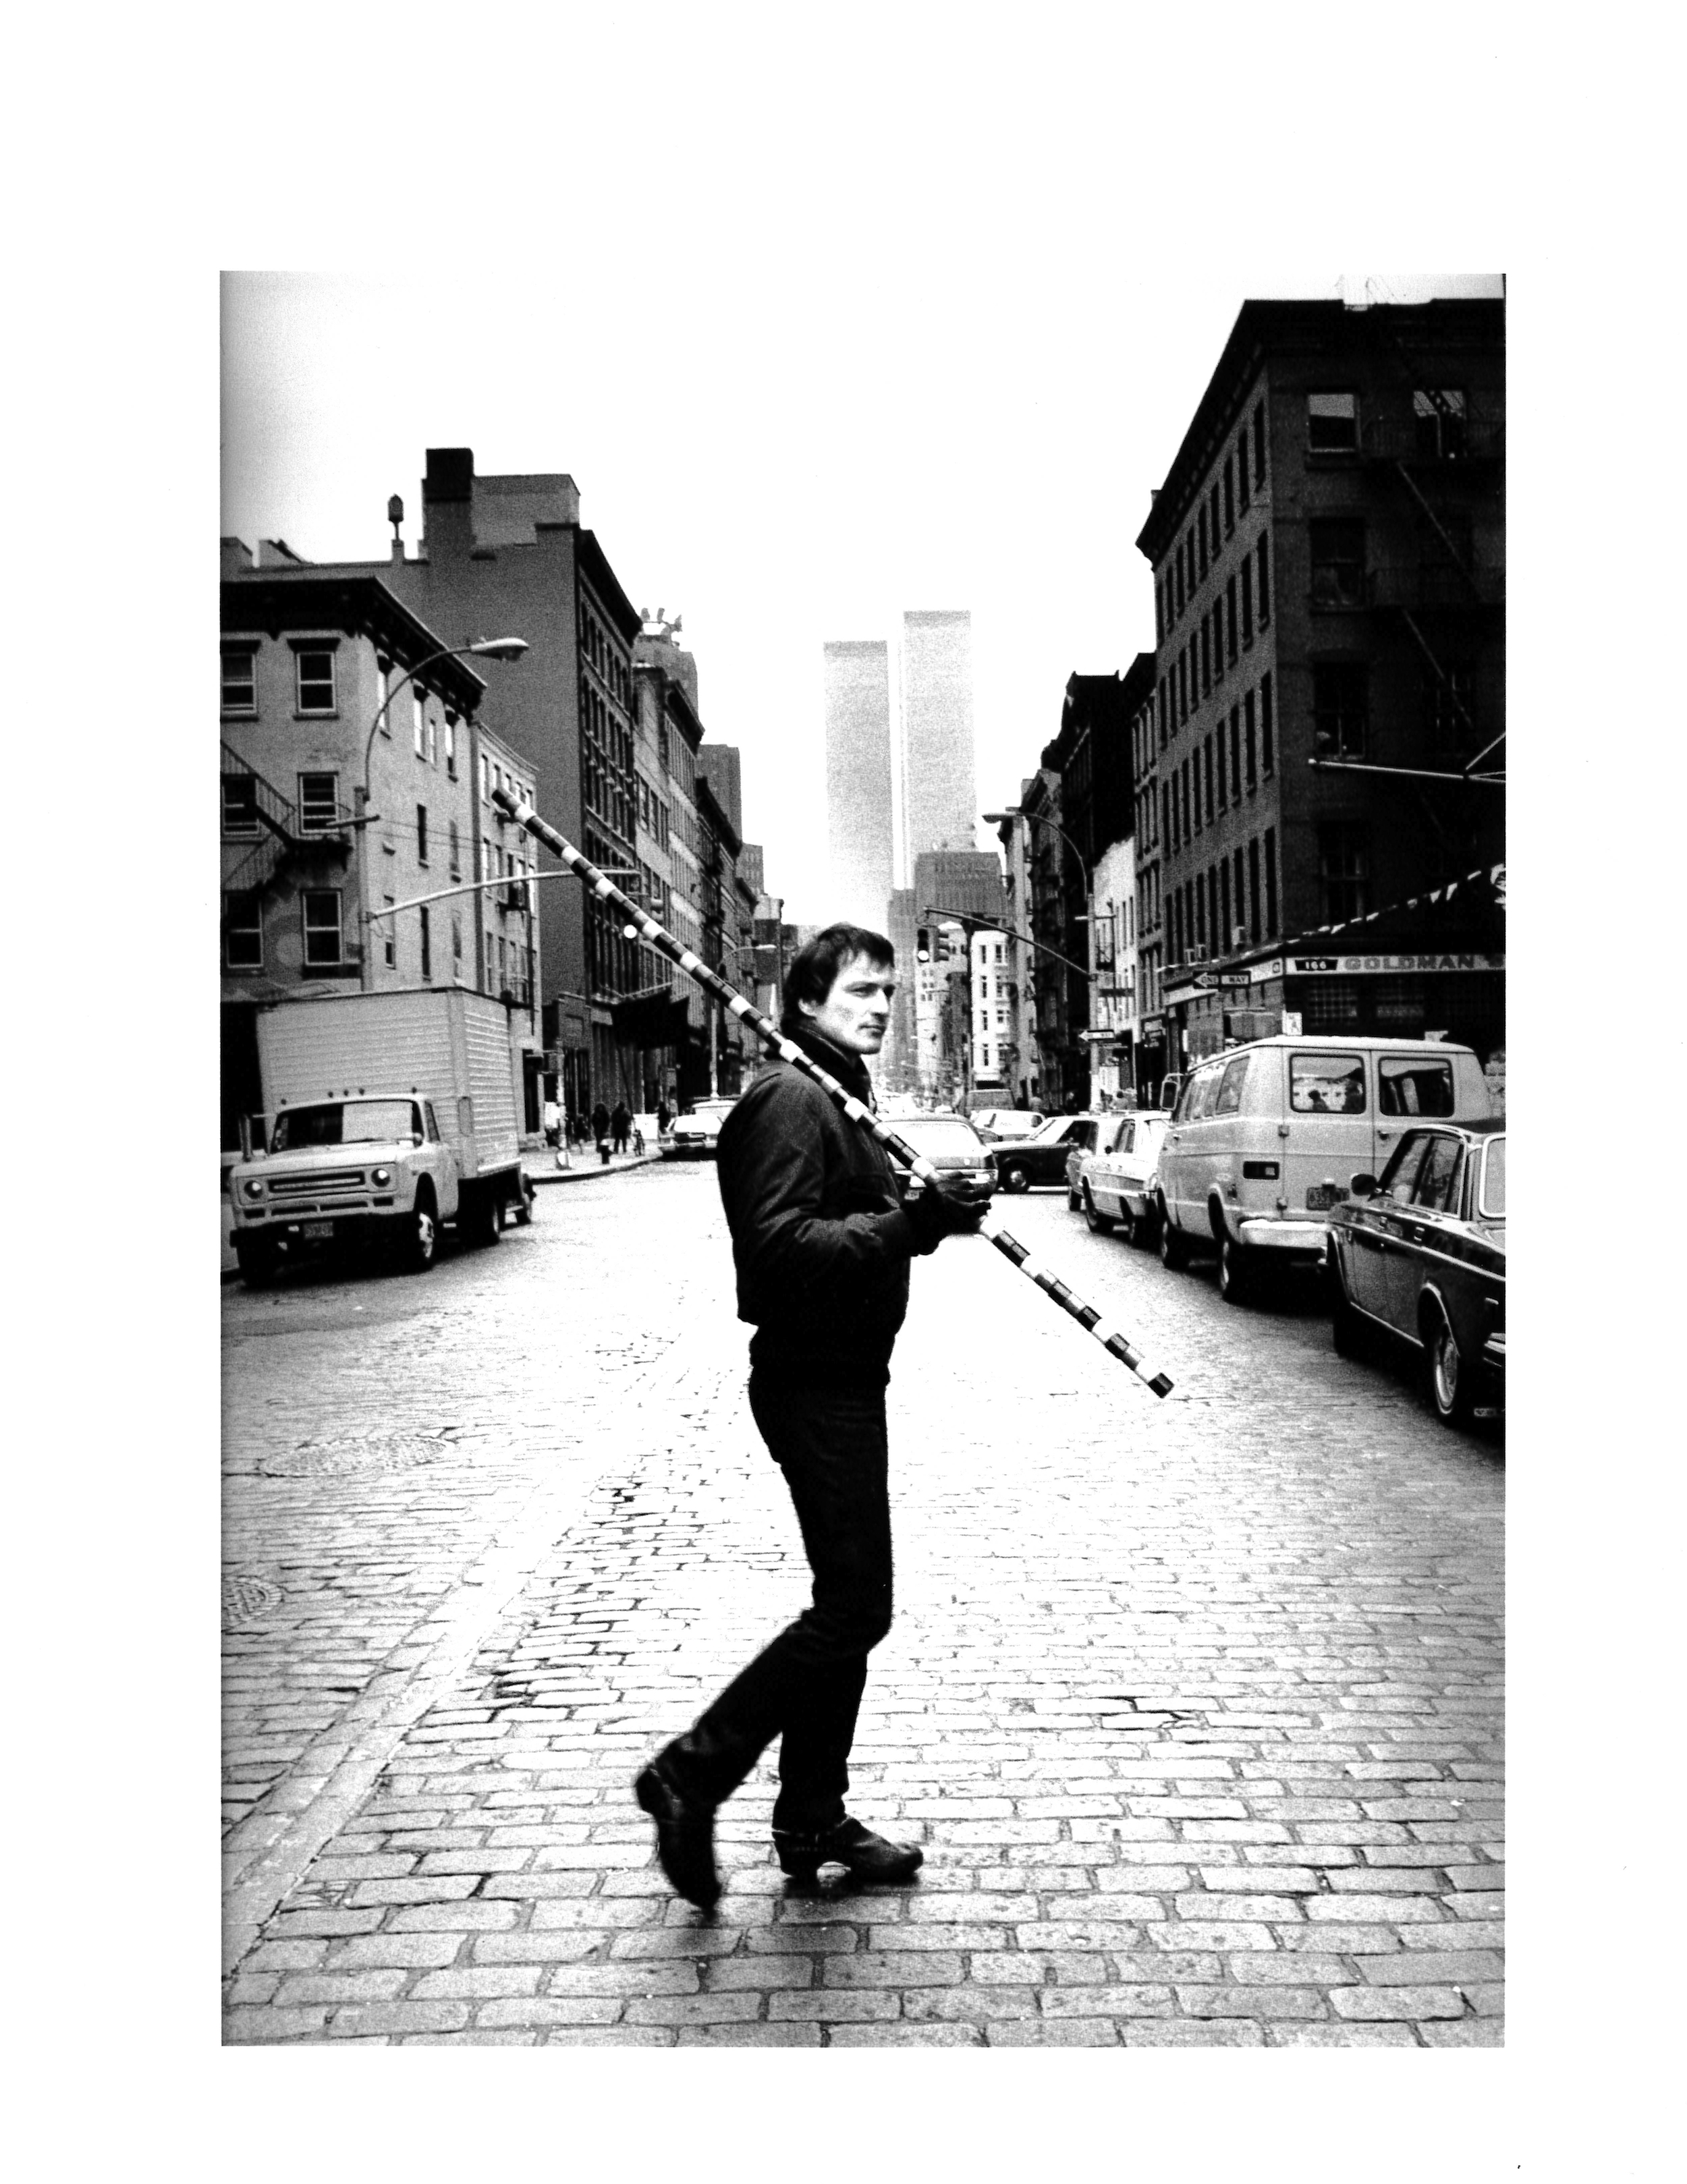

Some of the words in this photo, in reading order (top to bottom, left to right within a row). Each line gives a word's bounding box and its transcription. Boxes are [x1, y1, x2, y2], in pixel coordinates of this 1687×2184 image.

[1305, 961, 1327, 970] 166
[1344, 955, 1474, 970] GOLDMAN
[1201, 975, 1218, 984] ONE
[1228, 976, 1246, 984] WAY
